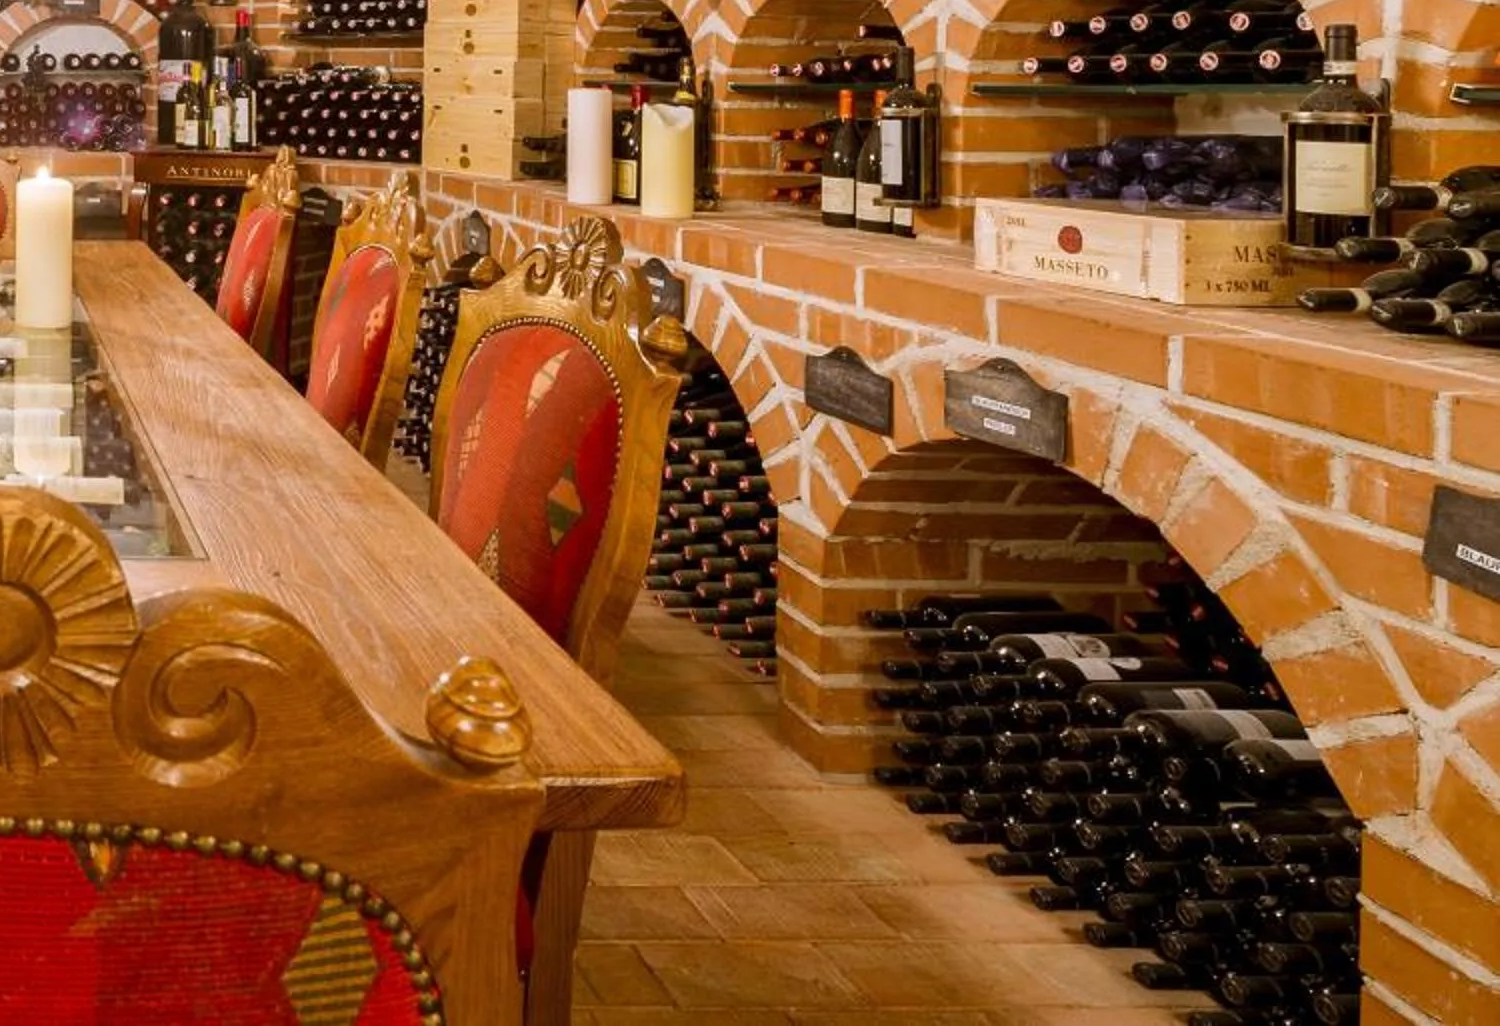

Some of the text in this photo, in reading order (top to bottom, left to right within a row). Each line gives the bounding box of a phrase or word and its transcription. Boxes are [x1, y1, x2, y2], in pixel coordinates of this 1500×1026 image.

[1233, 245, 1278, 264] MAS
[1034, 255, 1109, 280] MASSETO
[1459, 547, 1500, 572] BLAU
